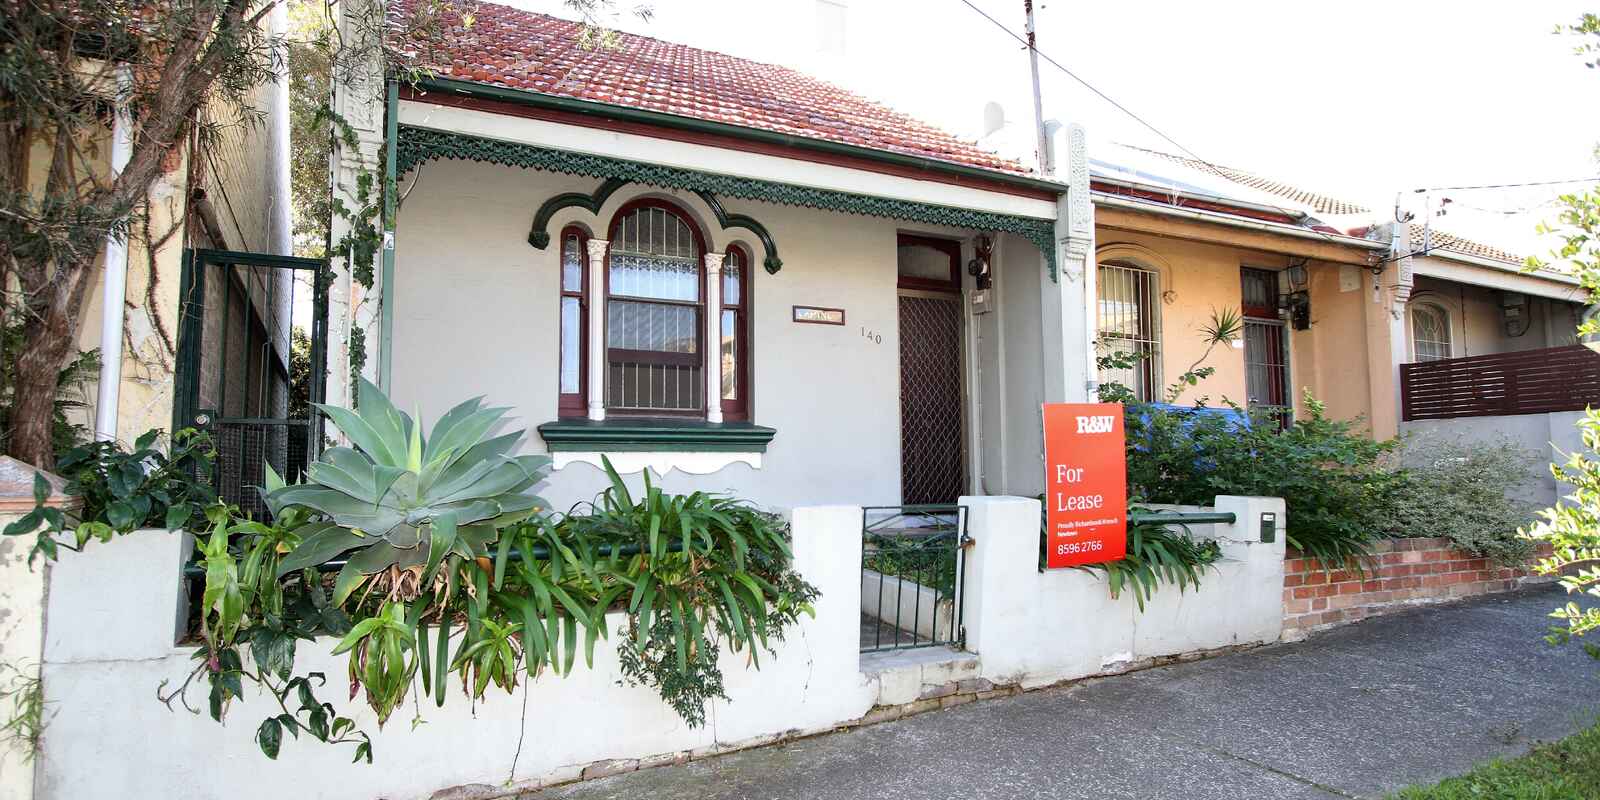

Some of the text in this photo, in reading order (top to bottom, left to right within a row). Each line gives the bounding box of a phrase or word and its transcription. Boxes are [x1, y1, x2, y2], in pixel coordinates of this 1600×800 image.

[861, 327, 882, 344] 140
[1075, 416, 1115, 434] R&W
[1056, 464, 1084, 484] For
[1057, 493, 1104, 512] Lease
[1057, 540, 1103, 555] 8596 2766
